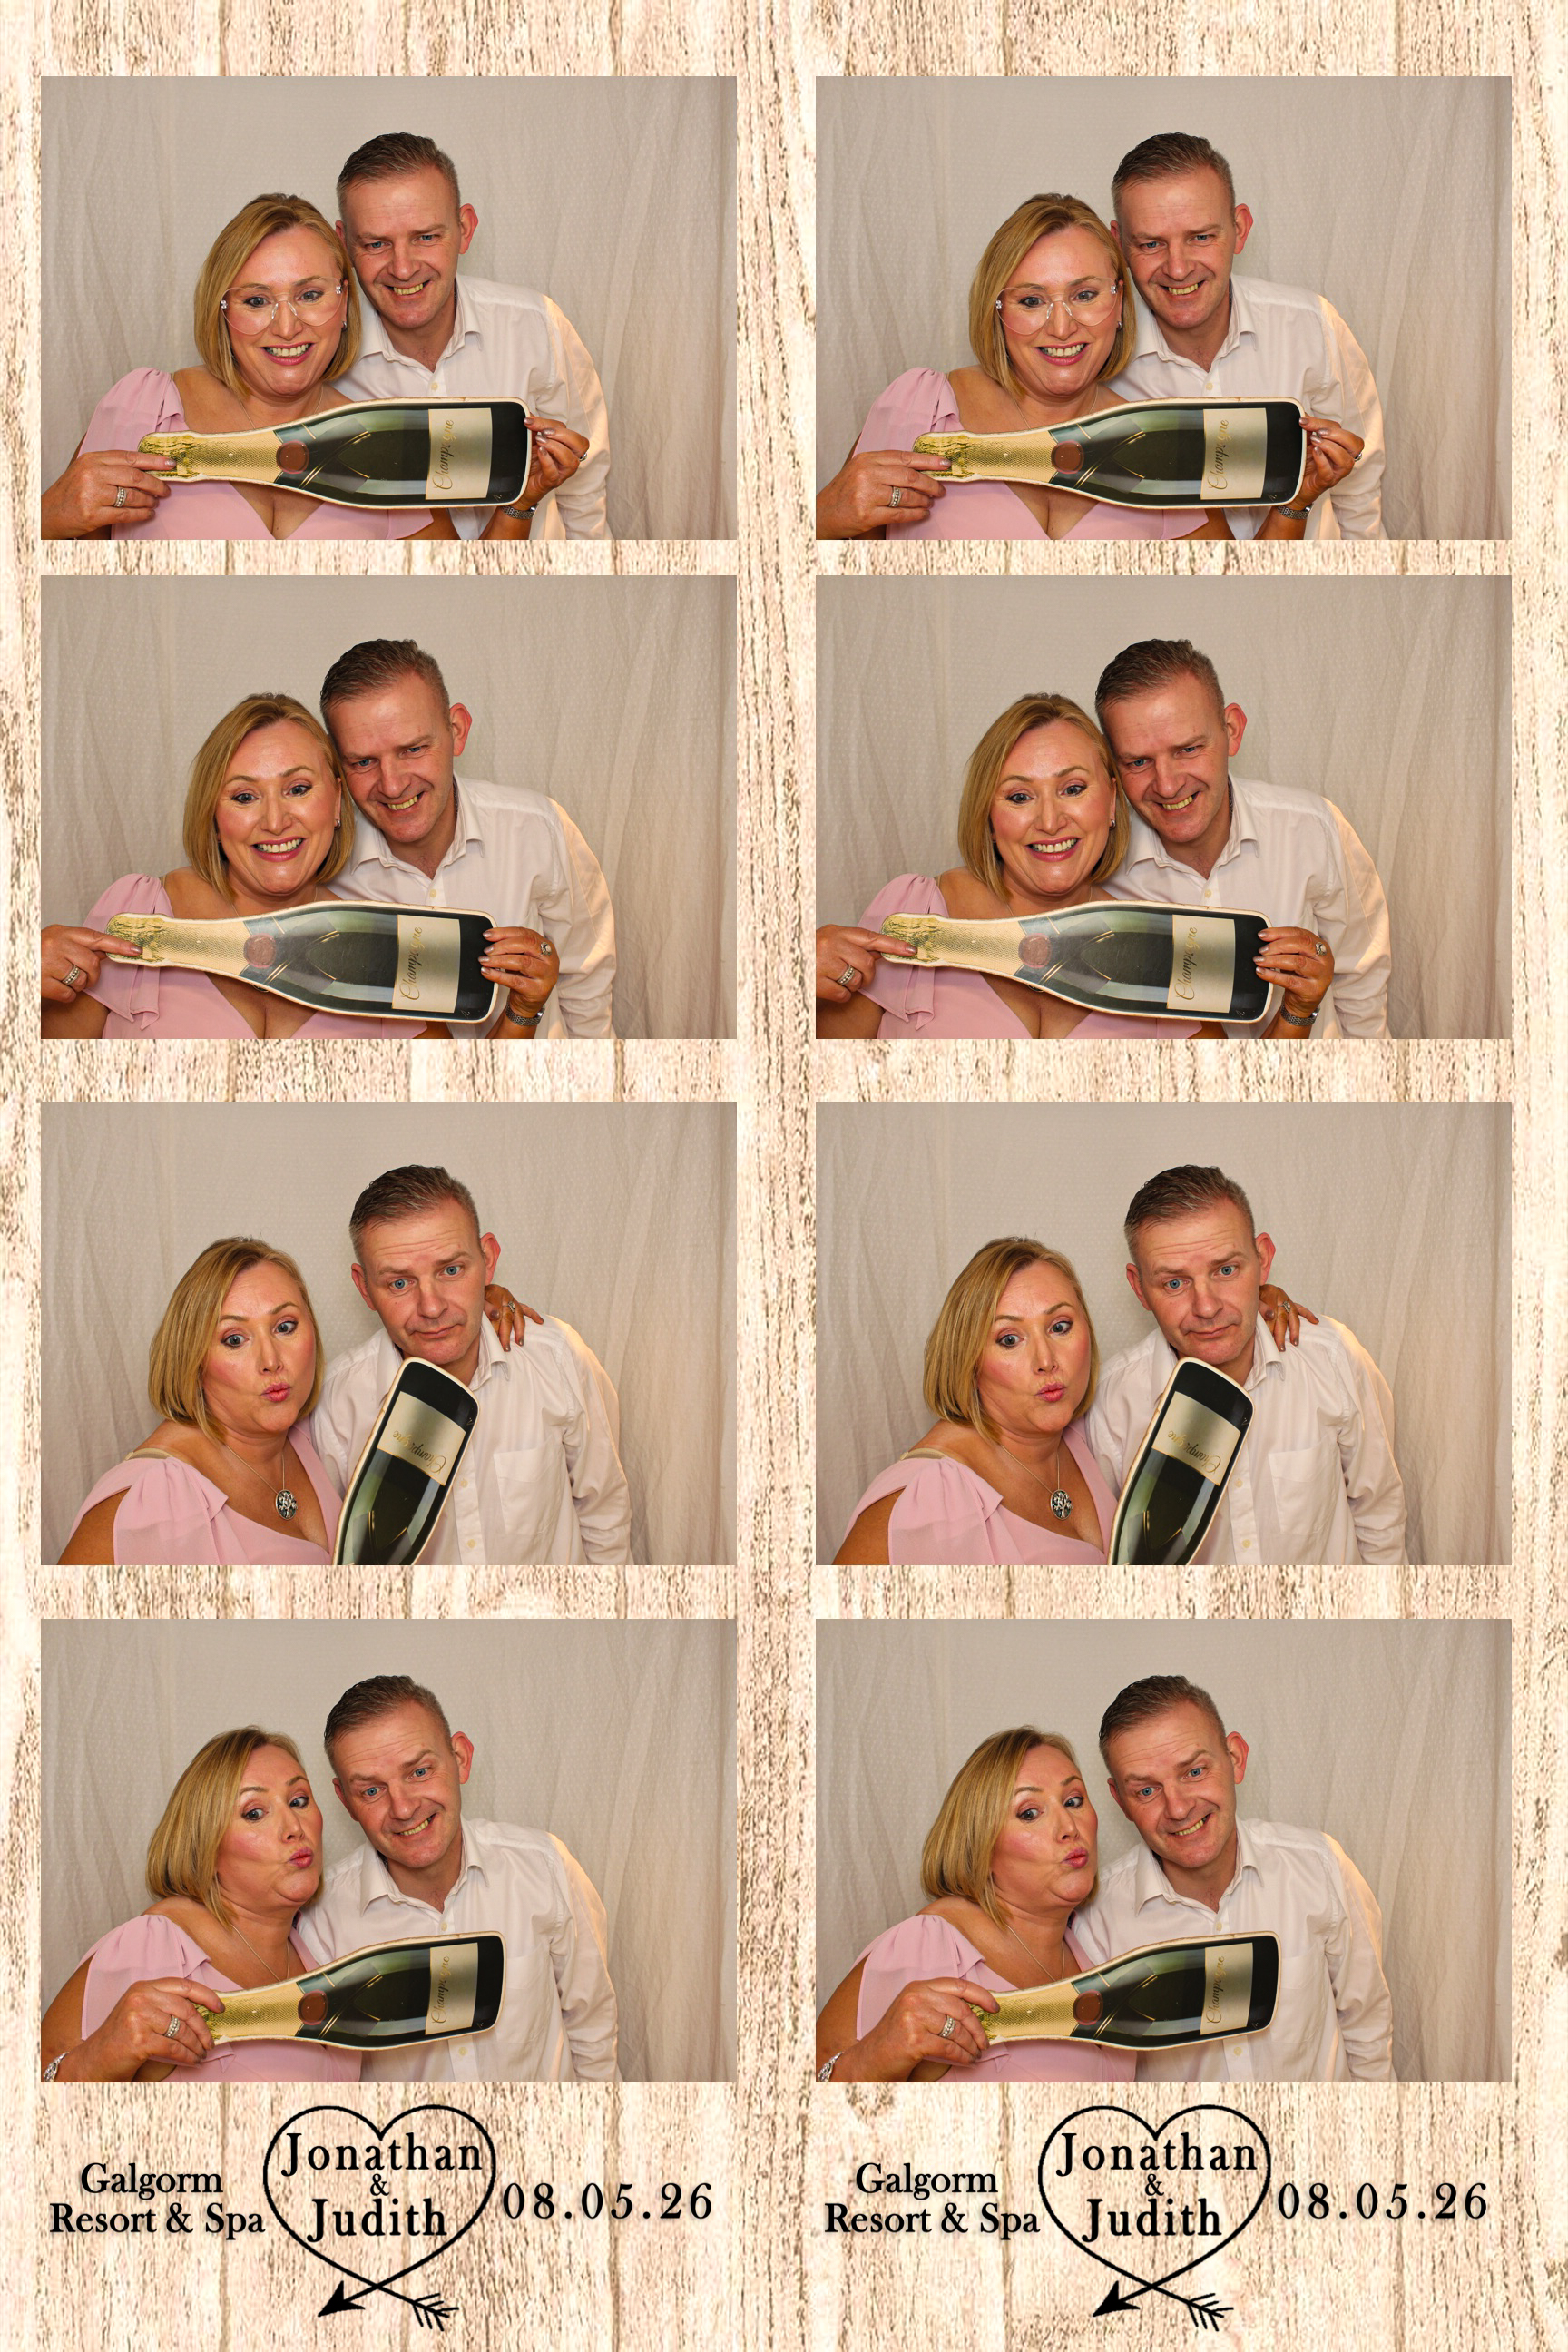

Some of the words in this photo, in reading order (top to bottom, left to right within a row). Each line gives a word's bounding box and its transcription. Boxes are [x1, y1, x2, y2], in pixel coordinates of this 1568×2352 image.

[432, 419, 457, 490] Champagne
[1207, 419, 1232, 490] Champagne
[399, 926, 425, 1001] Champagne
[1174, 926, 1200, 1001] Champagne
[430, 1955, 452, 2024] Champagne
[1205, 1955, 1227, 2024] Champagne
